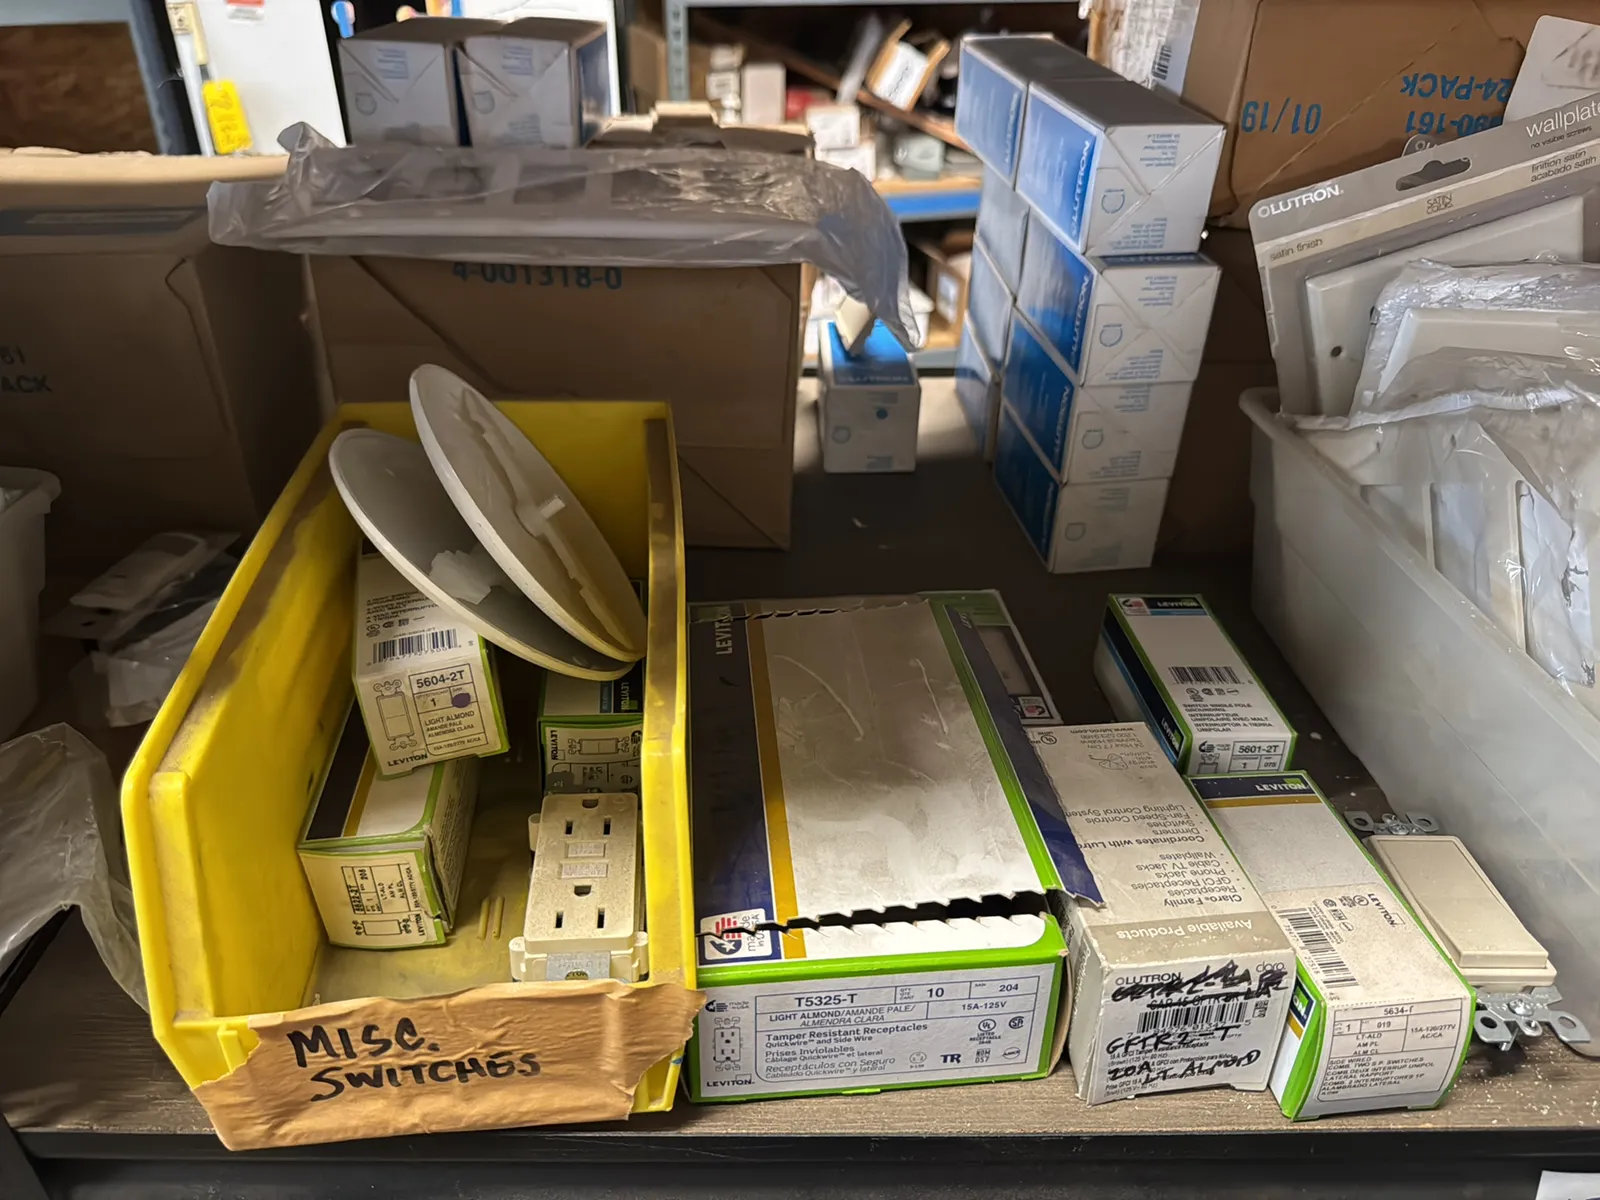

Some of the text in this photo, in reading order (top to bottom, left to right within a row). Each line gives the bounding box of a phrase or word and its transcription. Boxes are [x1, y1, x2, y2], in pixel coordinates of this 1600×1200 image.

[1241, 97, 1322, 135] 01/19
[1531, 142, 1540, 150] no
[1566, 125, 1592, 139] screws
[1531, 156, 1562, 173] finition
[1531, 164, 1572, 183] acabado
[1269, 237, 1323, 261] satin finish
[416, 670, 466, 689] 5604-2T
[430, 697, 438, 707] 1
[424, 710, 475, 727] LIGHT ALMOND
[426, 722, 449, 732] AMANDE
[427, 724, 475, 738] ALMENDRA CLARA
[550, 730, 559, 760] LEVITON
[1238, 744, 1279, 754] 5601-2T
[387, 753, 428, 768] LEVITON
[1256, 782, 1309, 792] LEVITON
[1104, 804, 1186, 816] Lighting Control
[1085, 812, 1190, 825] Fan-Speed Controls
[1146, 820, 1195, 828] Switches
[1152, 828, 1200, 836] Dimmers
[1108, 835, 1204, 848] Coordinates with
[1159, 851, 1216, 861] Wallplates
[1136, 862, 1168, 872] Jacks
[1188, 859, 1220, 868] Cable
[1154, 868, 1226, 880] Phone Jacks
[1131, 876, 1231, 890] GFCI Receptacles
[1168, 884, 1237, 898] Receptacles
[1163, 895, 1202, 908] Family
[1368, 892, 1399, 928] LEVITON
[414, 913, 426, 936] LEVITON
[1116, 918, 1252, 940] Available Products
[927, 983, 1019, 999] 10 204
[795, 993, 858, 1008] T5325-T
[962, 1000, 1008, 1011] 15A-125V
[770, 1004, 916, 1022] LIGHT ALMOND/AMANDE PALE/
[800, 1014, 885, 1028] ALMENDRA CLARA
[1346, 1024, 1351, 1032] 1
[1376, 1020, 1392, 1029] 019
[766, 1023, 928, 1042] Tamper Resistant Receptacles
[834, 1036, 852, 1044] Side
[854, 1034, 874, 1042] Wire
[1356, 1033, 1382, 1041] LT-ALD
[1420, 1032, 1443, 1041] AC/CA
[286, 1017, 440, 1068] MISC.
[766, 1045, 855, 1058] Prises Inviolables
[856, 1048, 883, 1058] lateral
[766, 1056, 896, 1075] Receptáculos con Seguro
[940, 1054, 962, 1064] TR
[1386, 1056, 1424, 1066] SWITCHES
[310, 1051, 542, 1101] SWITCHES
[766, 1070, 804, 1080] Cableado
[859, 1064, 886, 1073] lateral
[1360, 1070, 1394, 1078] RAPPORT
[706, 1078, 755, 1088] LEVITON
[1354, 1074, 1414, 1084] INTERRUPTORES
[1322, 1080, 1401, 1092] ALAMBRADO LATERAL
